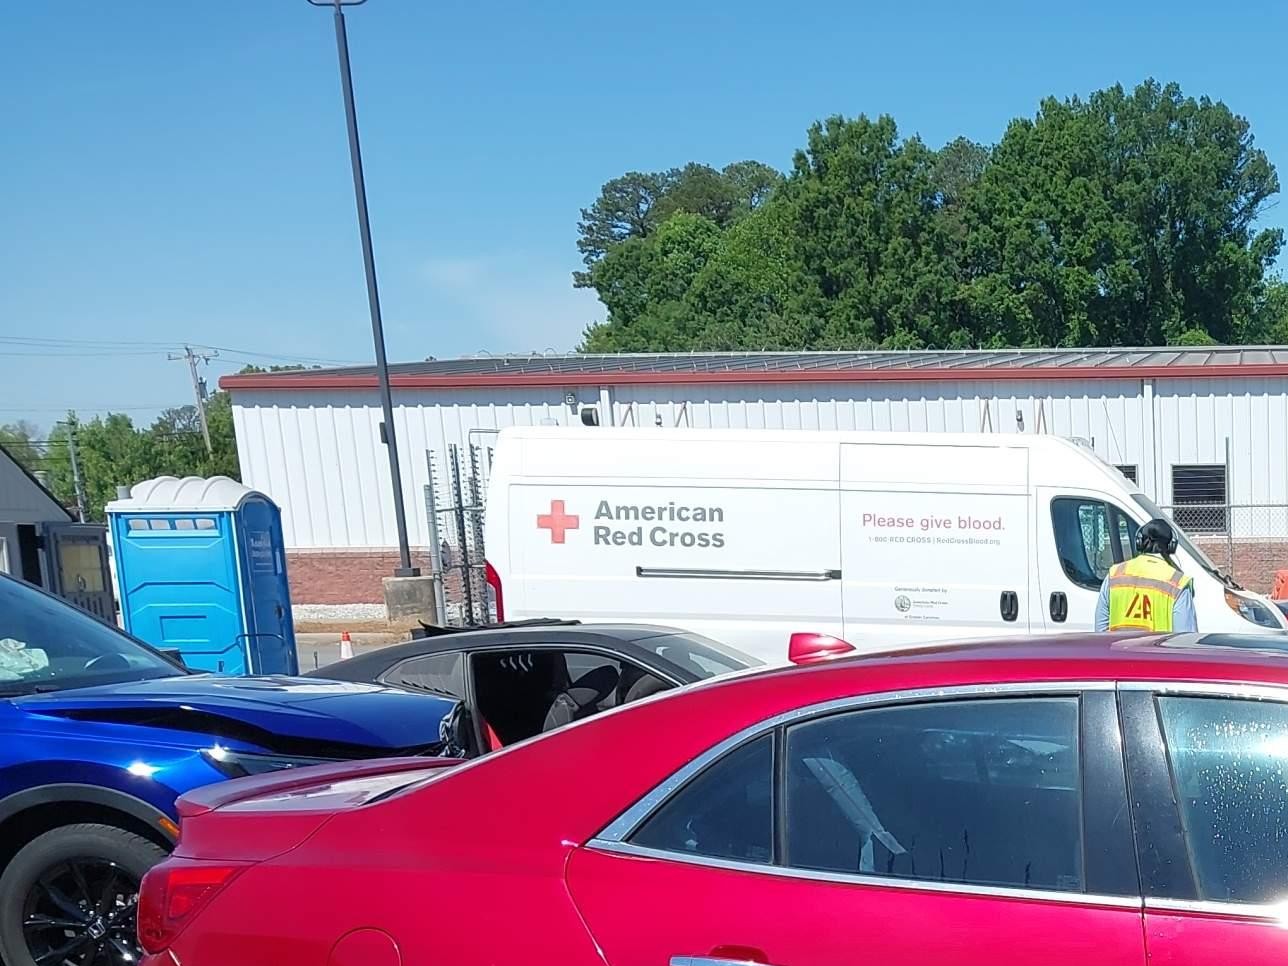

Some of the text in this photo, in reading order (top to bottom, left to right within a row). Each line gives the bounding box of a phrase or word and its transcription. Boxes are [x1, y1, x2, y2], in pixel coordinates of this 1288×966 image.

[594, 499, 724, 522] American
[862, 513, 1006, 532] Please give blood.
[593, 525, 725, 548] Red Cross
